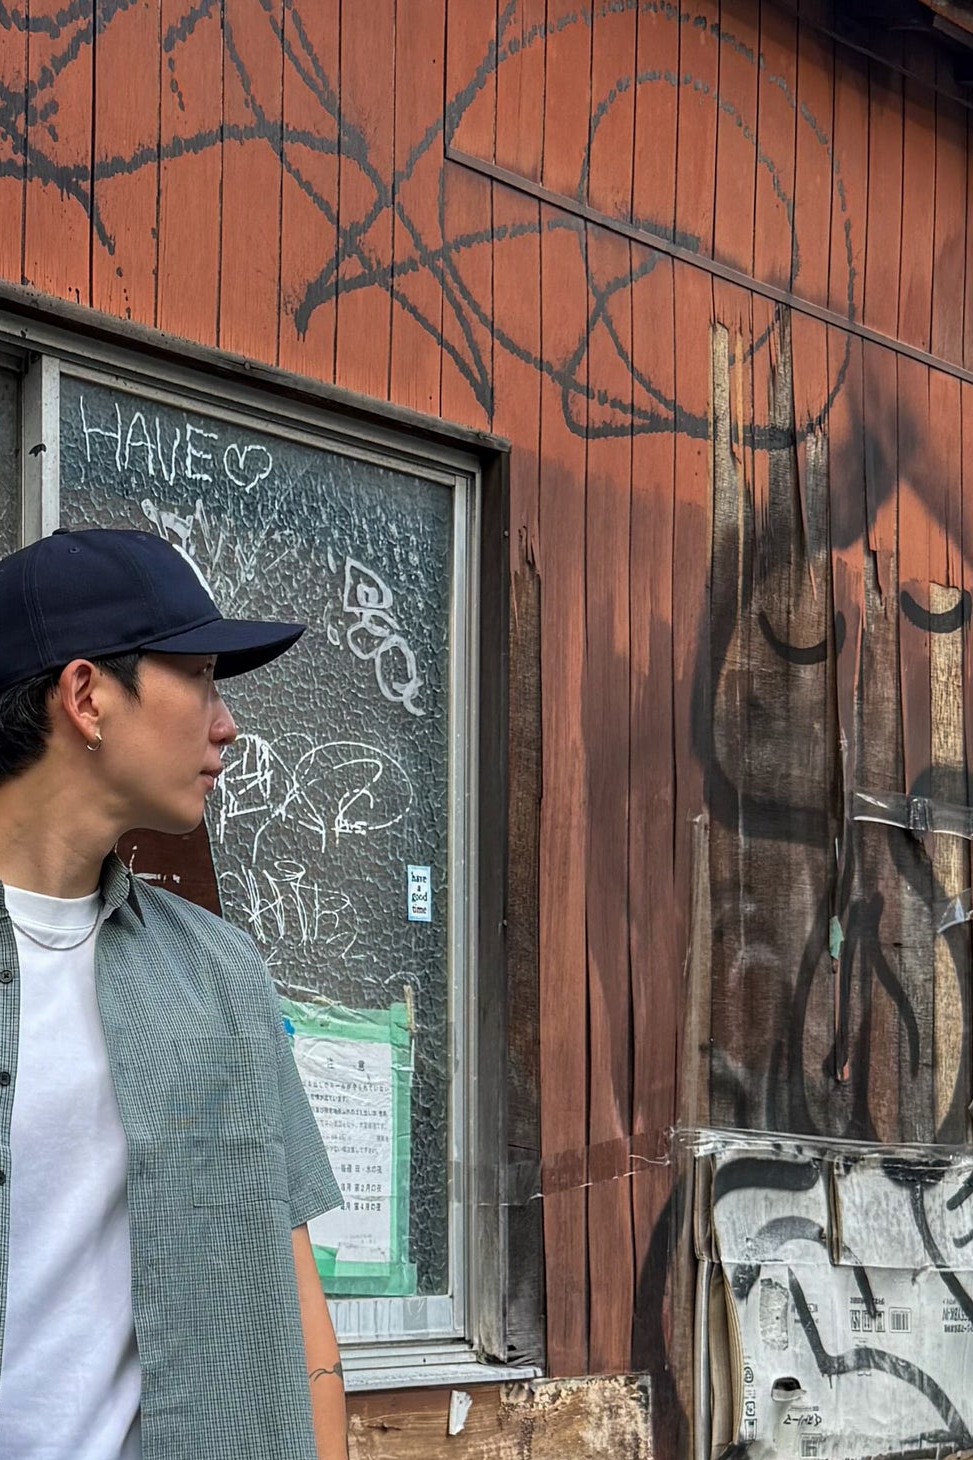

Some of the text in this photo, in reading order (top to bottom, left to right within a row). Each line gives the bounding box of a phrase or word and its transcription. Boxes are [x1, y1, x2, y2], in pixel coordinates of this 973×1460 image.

[79, 396, 219, 486] HAVE
[411, 871, 427, 883] have
[412, 892, 427, 902] good
[412, 904, 427, 914] time
